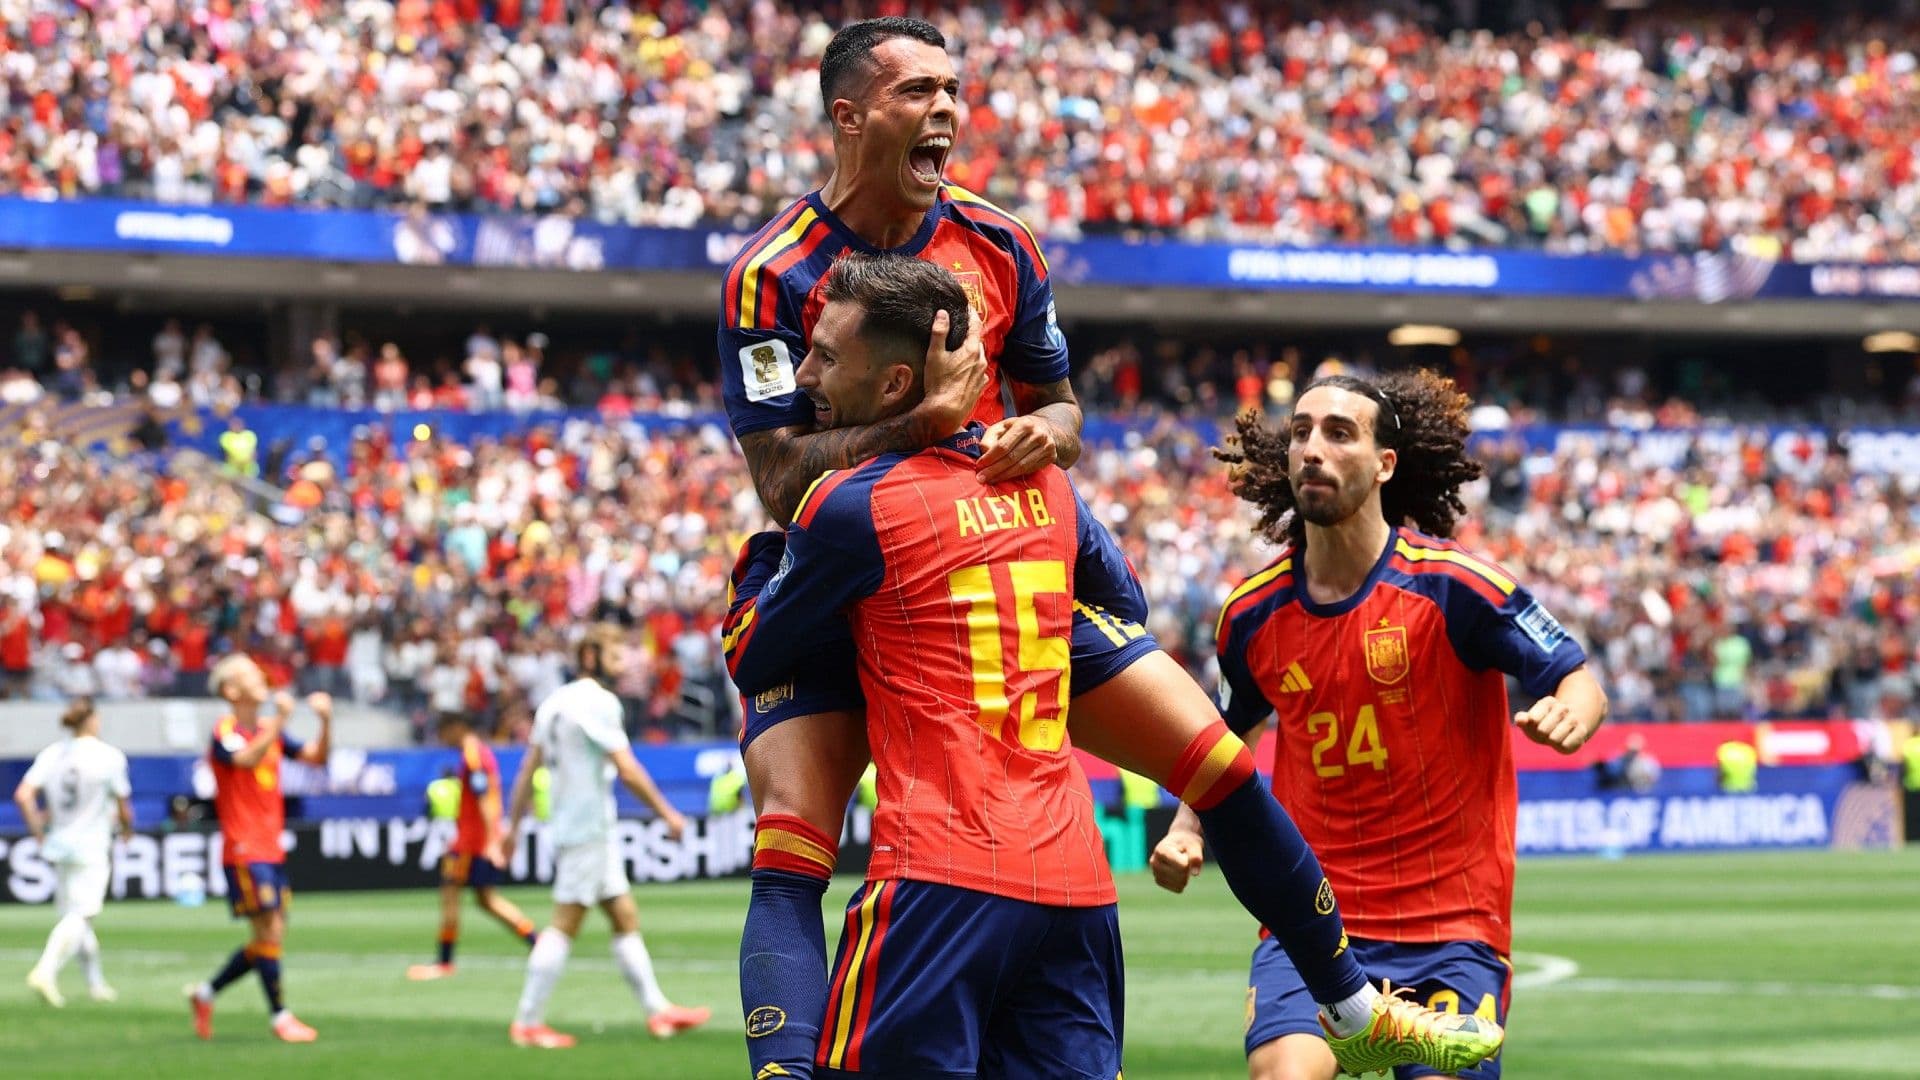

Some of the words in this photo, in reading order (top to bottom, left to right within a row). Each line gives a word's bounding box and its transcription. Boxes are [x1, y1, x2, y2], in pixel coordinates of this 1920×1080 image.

[955, 491, 1028, 537] ALEX
[1025, 488, 1056, 527] B.
[948, 560, 1071, 752] 15
[1308, 704, 1388, 778] 24
[1517, 799, 1605, 849] ATES
[1660, 795, 1828, 846] AMERICA
